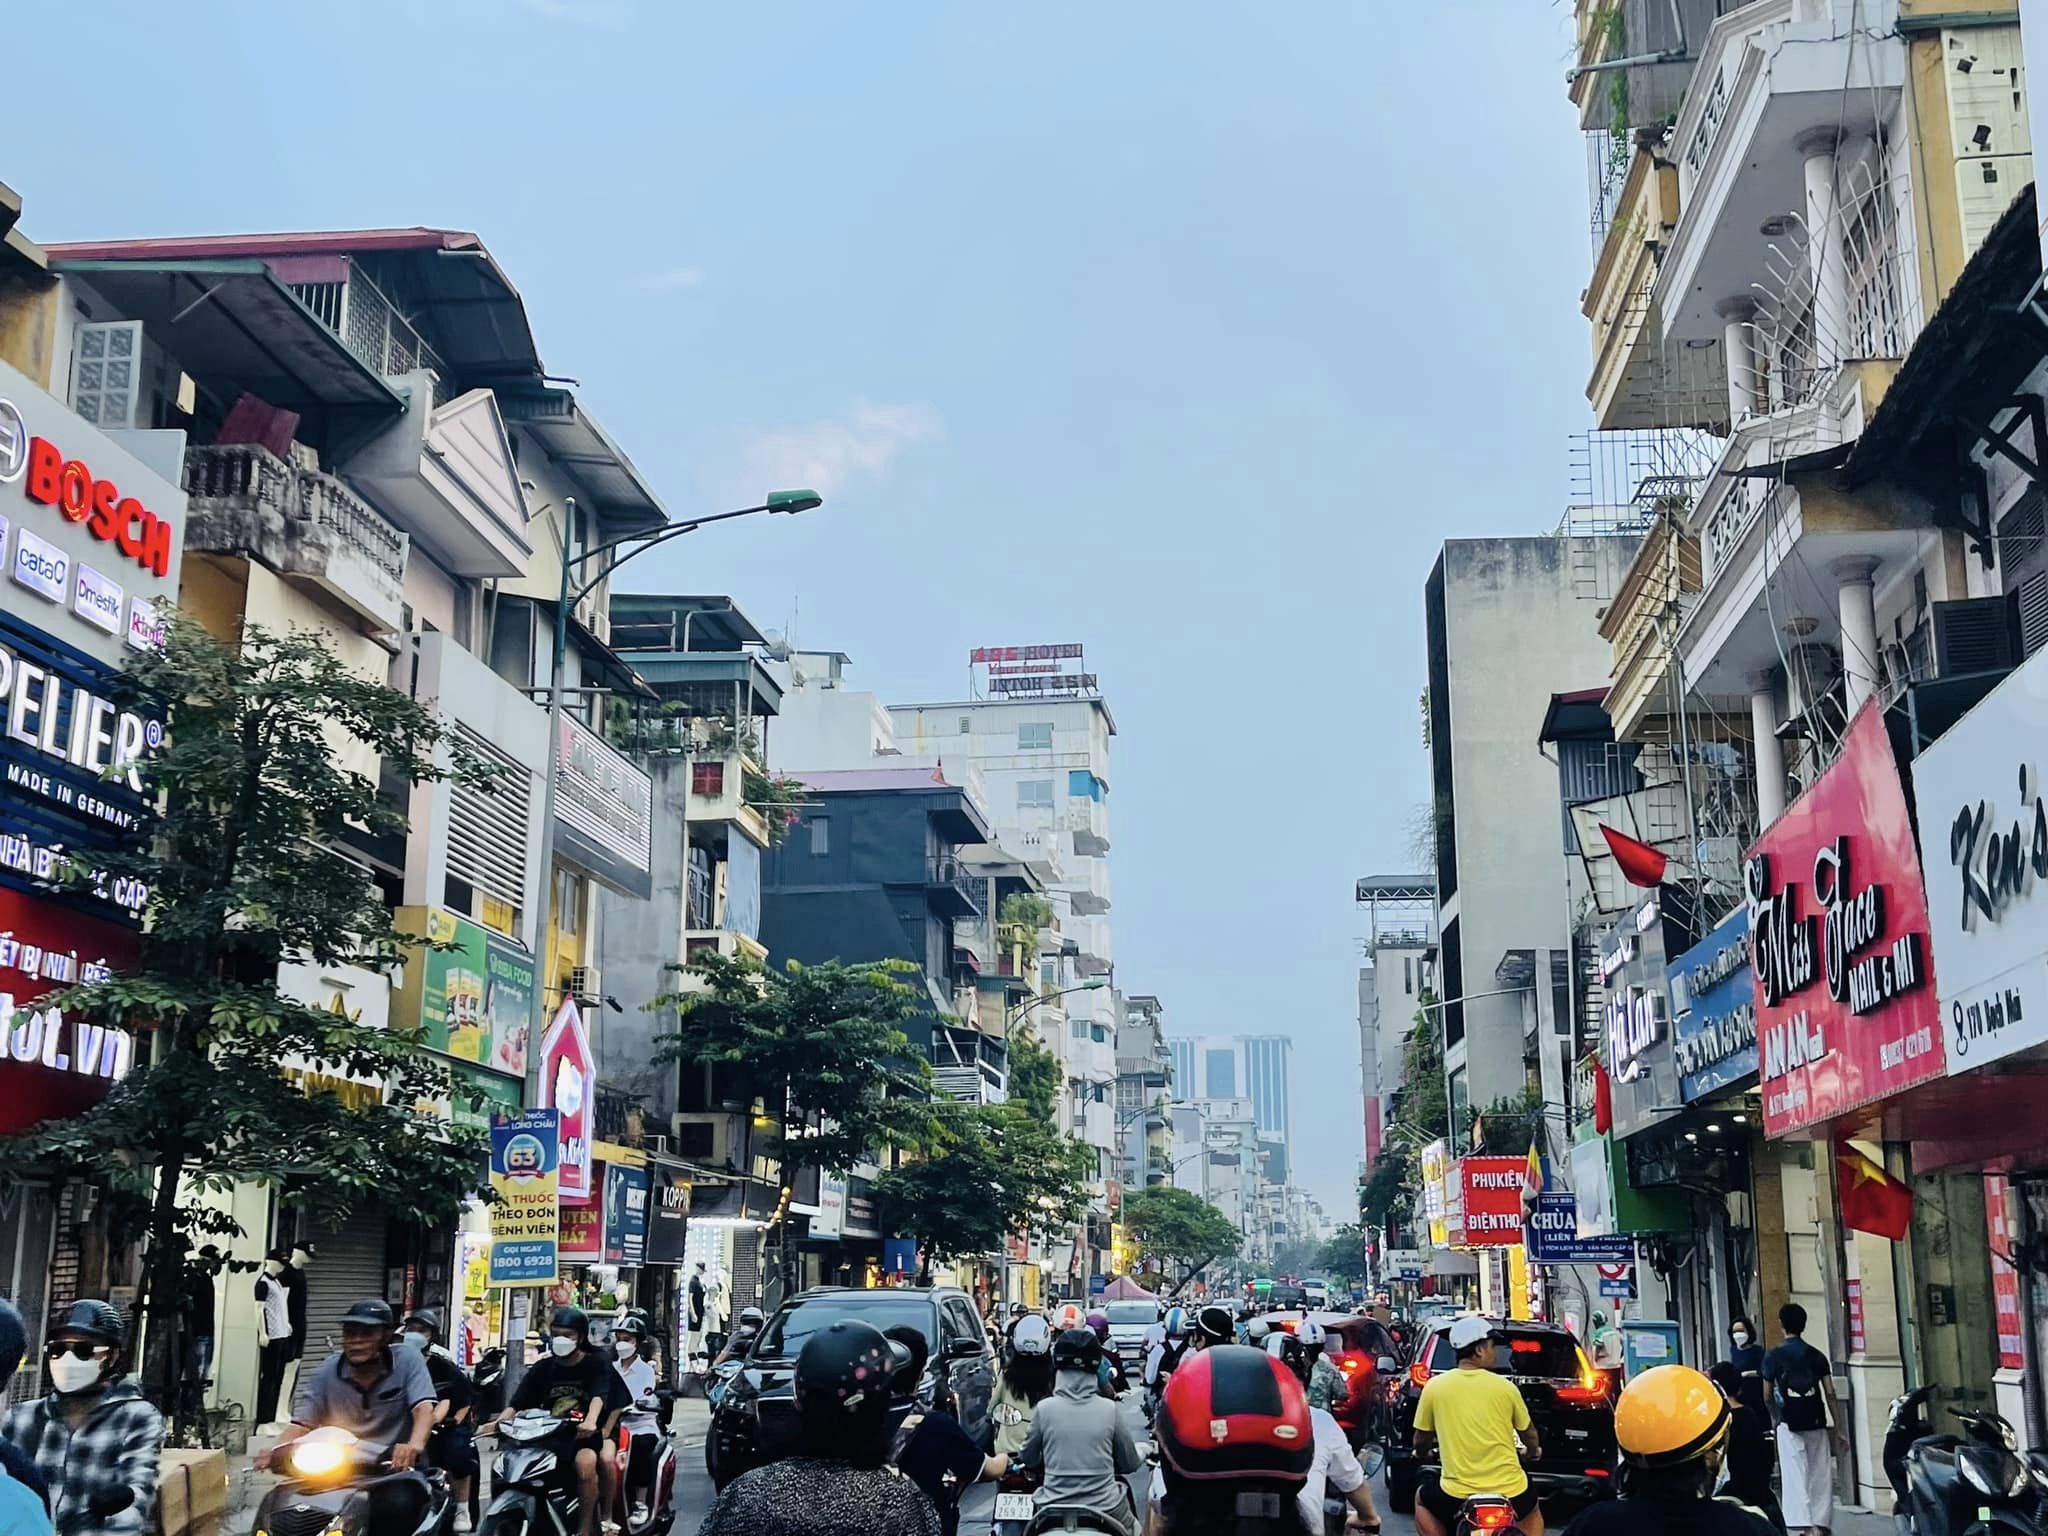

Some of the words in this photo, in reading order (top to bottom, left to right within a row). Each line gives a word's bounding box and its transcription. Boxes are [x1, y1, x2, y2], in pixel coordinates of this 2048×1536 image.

[27, 436, 171, 577] BOSCH
[8, 765, 49, 795] MADE
[57, 785, 71, 804] IN
[1848, 957, 1880, 1015] NAIL
[1882, 956, 1892, 997] &
[1892, 934, 1914, 991] MI
[512, 1191, 554, 1204] THUỐC
[492, 1208, 523, 1220] THEO
[526, 1207, 555, 1219] ĐƠN
[1531, 1207, 1576, 1230] CHÙA
[491, 1223, 523, 1236] BỆNH
[526, 1222, 556, 1236] VIỆN
[493, 1256, 521, 1268] 1800
[523, 1255, 553, 1266] 6928
